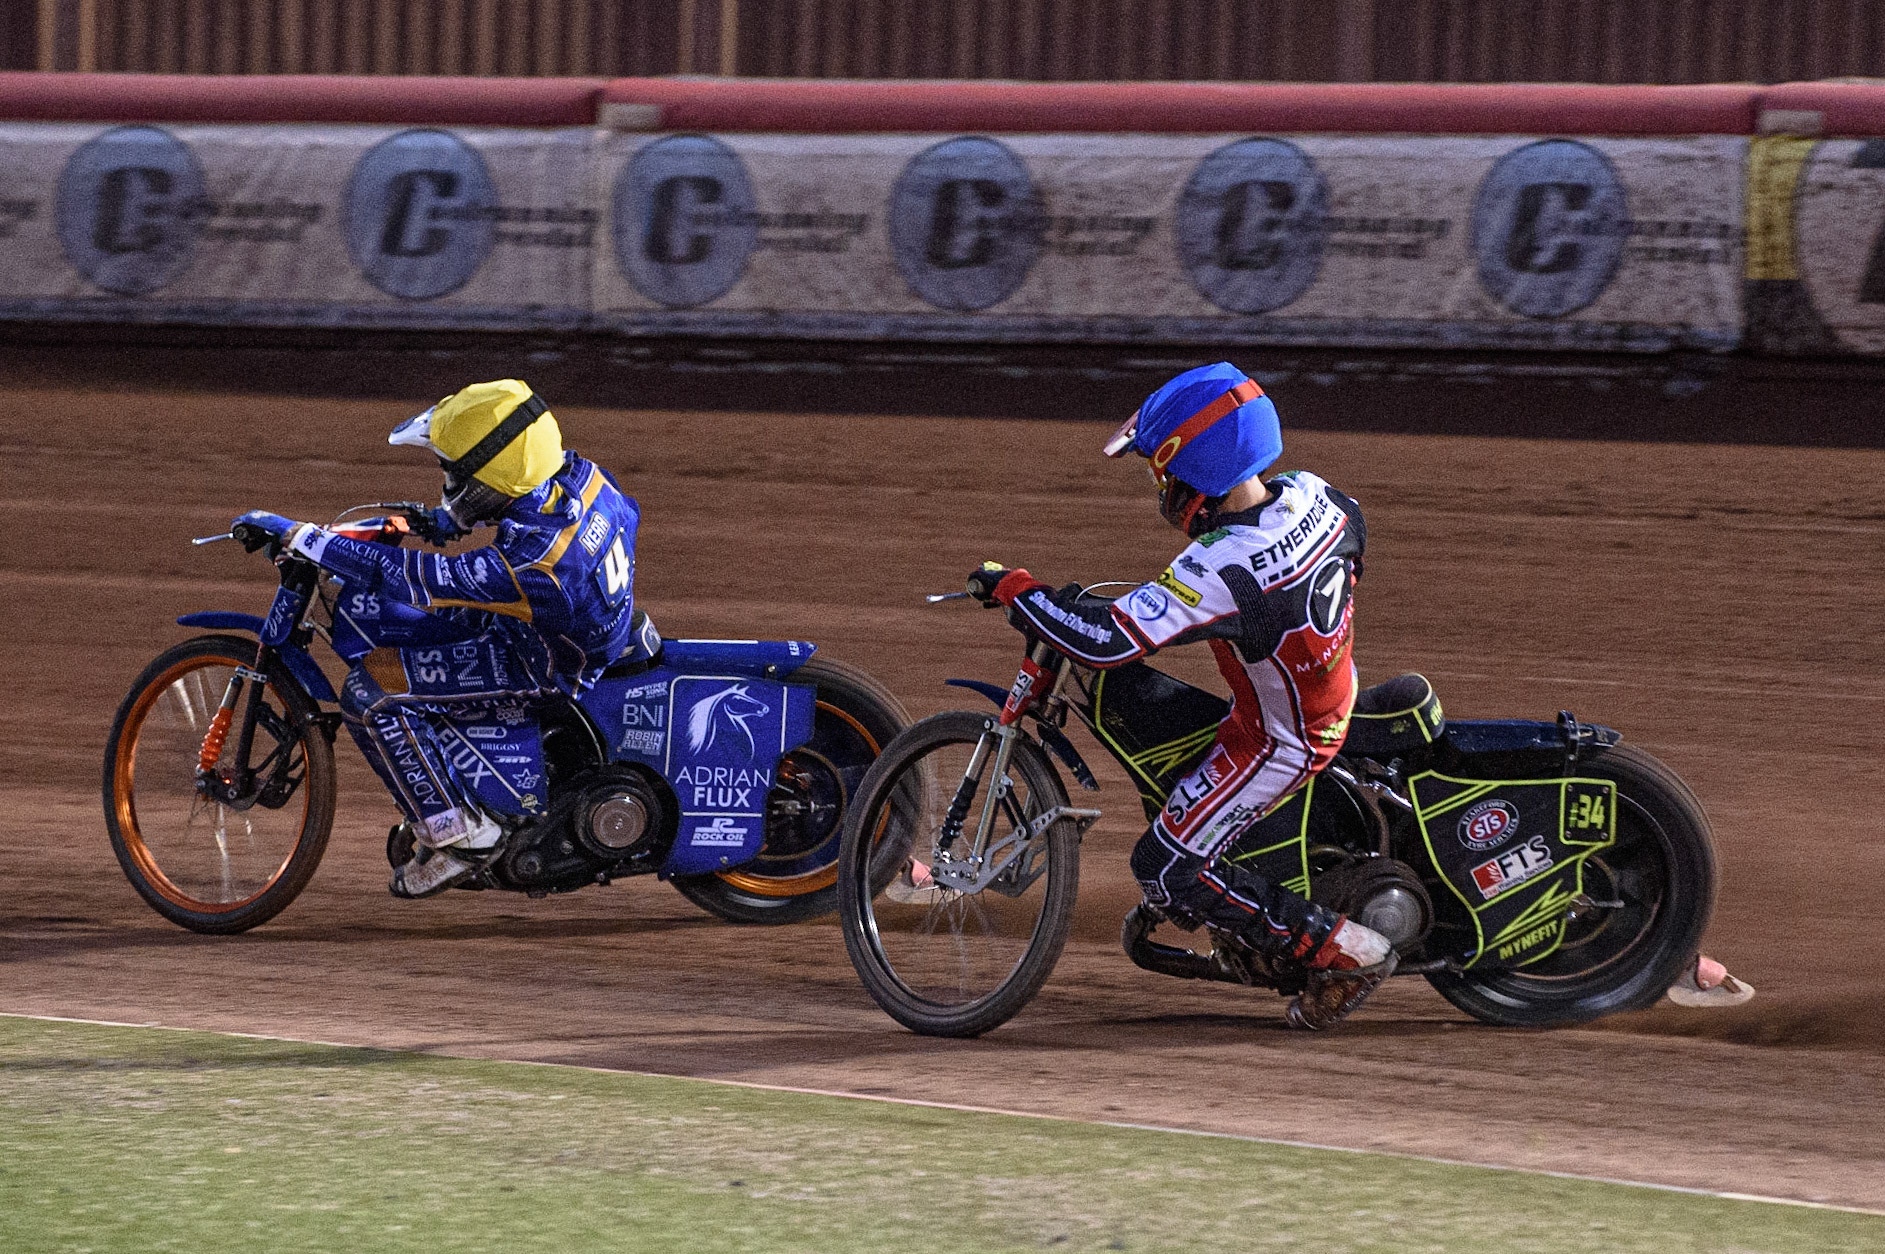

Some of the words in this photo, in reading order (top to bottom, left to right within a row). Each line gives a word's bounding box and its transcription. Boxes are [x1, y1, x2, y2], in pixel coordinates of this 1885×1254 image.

[581, 512, 609, 555] KERR
[1249, 493, 1328, 571] ETHERIDGE
[604, 536, 630, 594] 4
[1320, 566, 1346, 630] 7
[1063, 612, 1113, 644] Etheridge
[622, 703, 663, 727] BNI
[480, 743, 521, 751] BRIGGSY
[626, 730, 663, 742] ROBIN
[390, 738, 442, 805] ADRIAN
[675, 766, 770, 788] ADRIAN
[693, 787, 751, 808] FLUX
[1166, 770, 1216, 824] FTS
[692, 832, 725, 840] ROCK
[726, 833, 745, 841] OIL
[1474, 813, 1502, 838] STS
[1497, 837, 1549, 879] FTS
[1500, 919, 1558, 960] MYNEFIT
